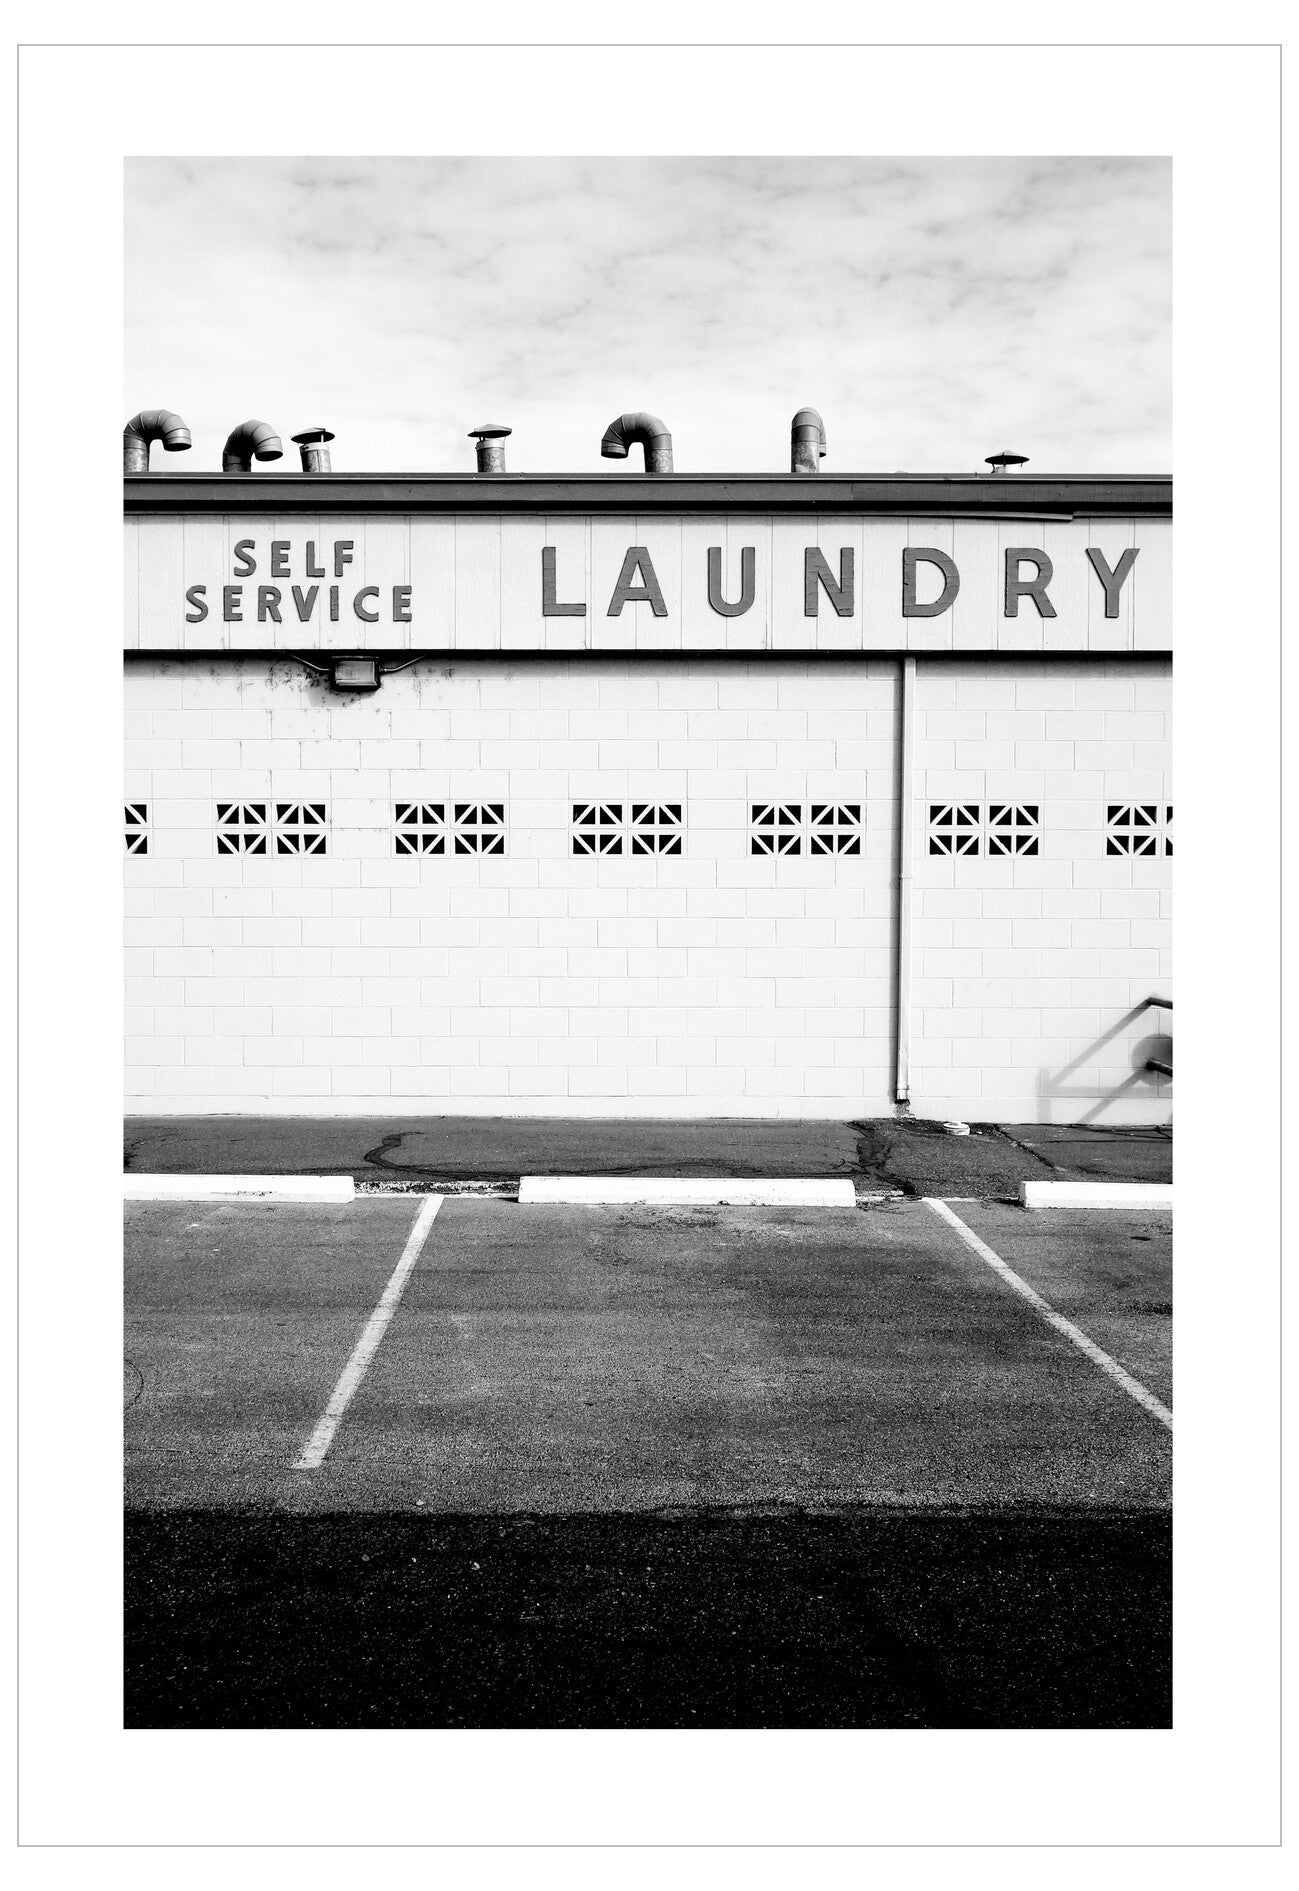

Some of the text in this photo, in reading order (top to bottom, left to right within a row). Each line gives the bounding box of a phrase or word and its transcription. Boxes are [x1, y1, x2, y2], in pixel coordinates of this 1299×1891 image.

[233, 539, 355, 578] SELF
[541, 546, 1141, 619] LAUNDRY
[185, 584, 413, 624] SERVICE
